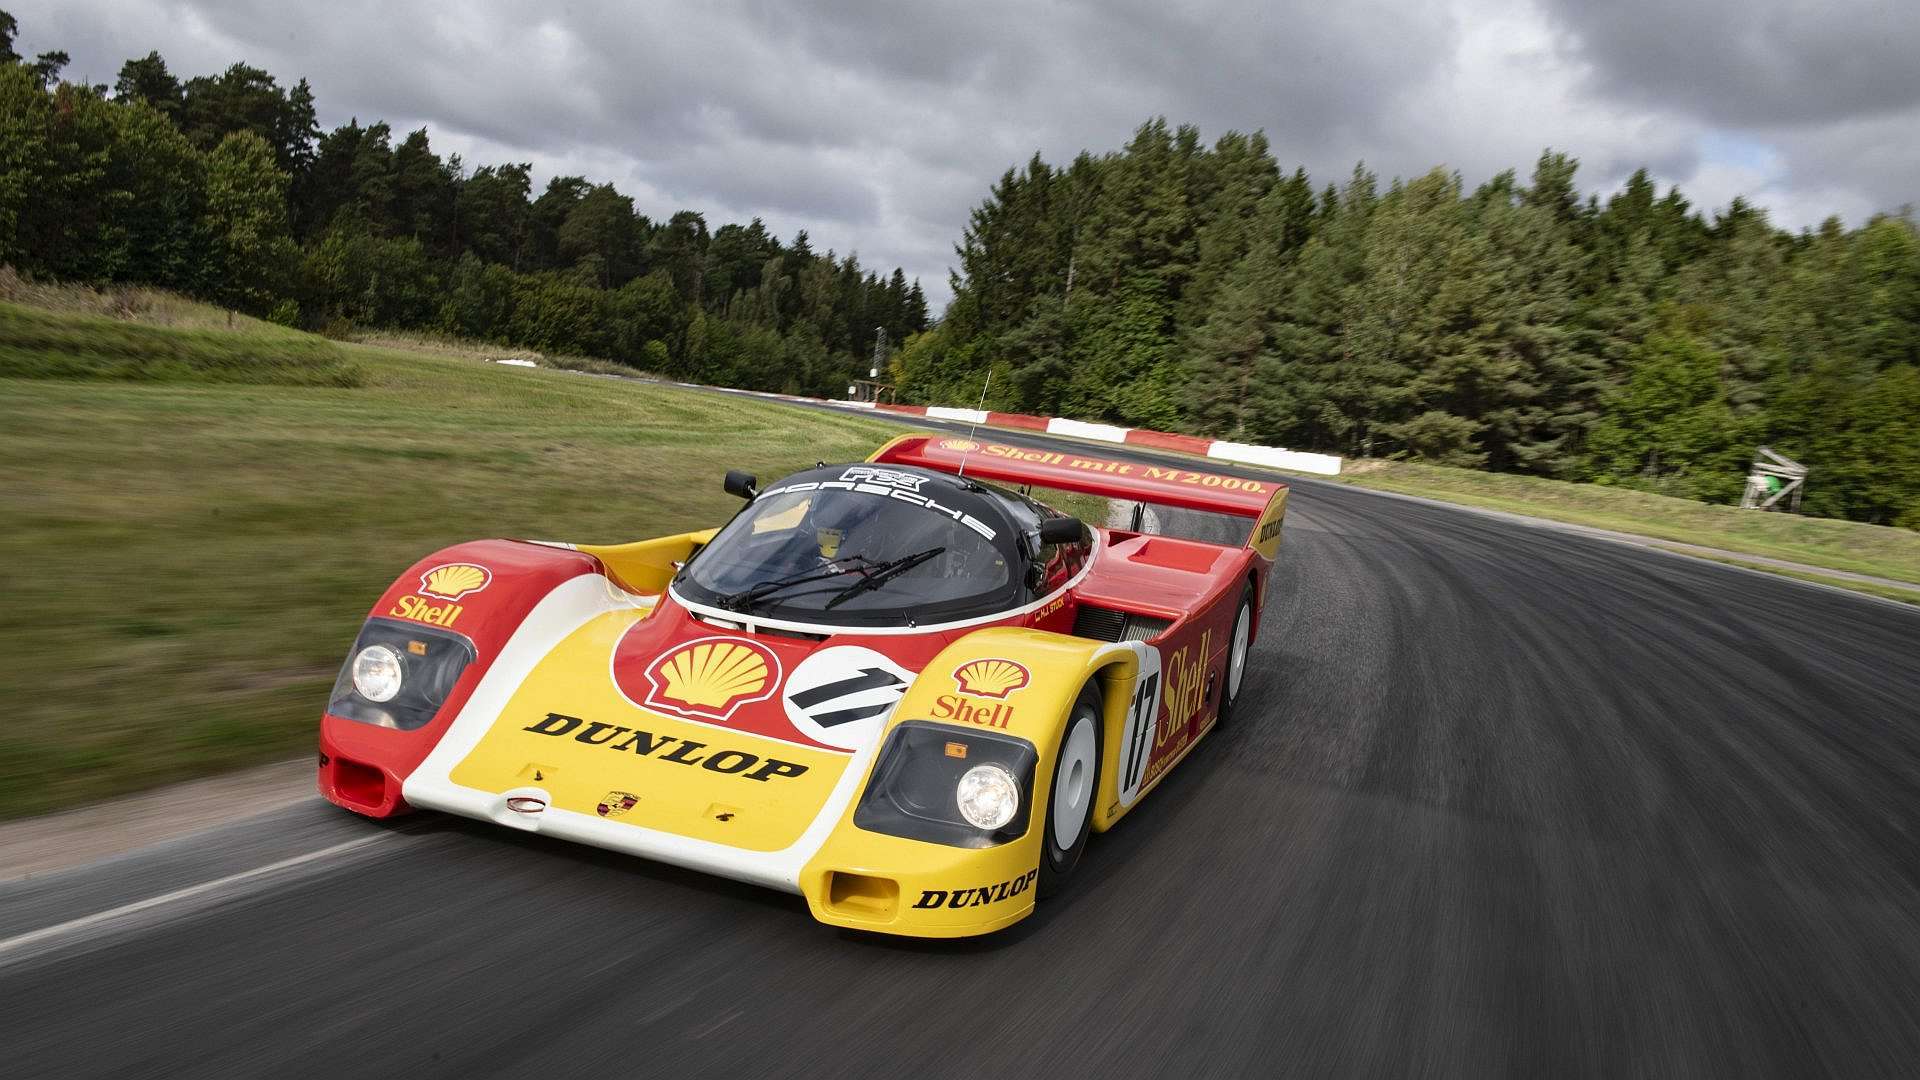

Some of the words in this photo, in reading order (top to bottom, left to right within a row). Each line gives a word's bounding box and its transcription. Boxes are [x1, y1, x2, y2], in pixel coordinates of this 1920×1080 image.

[981, 444, 1065, 464] Shell
[1070, 456, 1135, 474] mit
[753, 481, 997, 540] PORSCHE
[390, 595, 463, 628] Shell
[930, 695, 1014, 729] Shell
[1155, 628, 1212, 750] Shell
[523, 712, 811, 782] DUNLOP
[1122, 671, 1159, 794] 17
[912, 868, 1038, 910] DUNLOP
